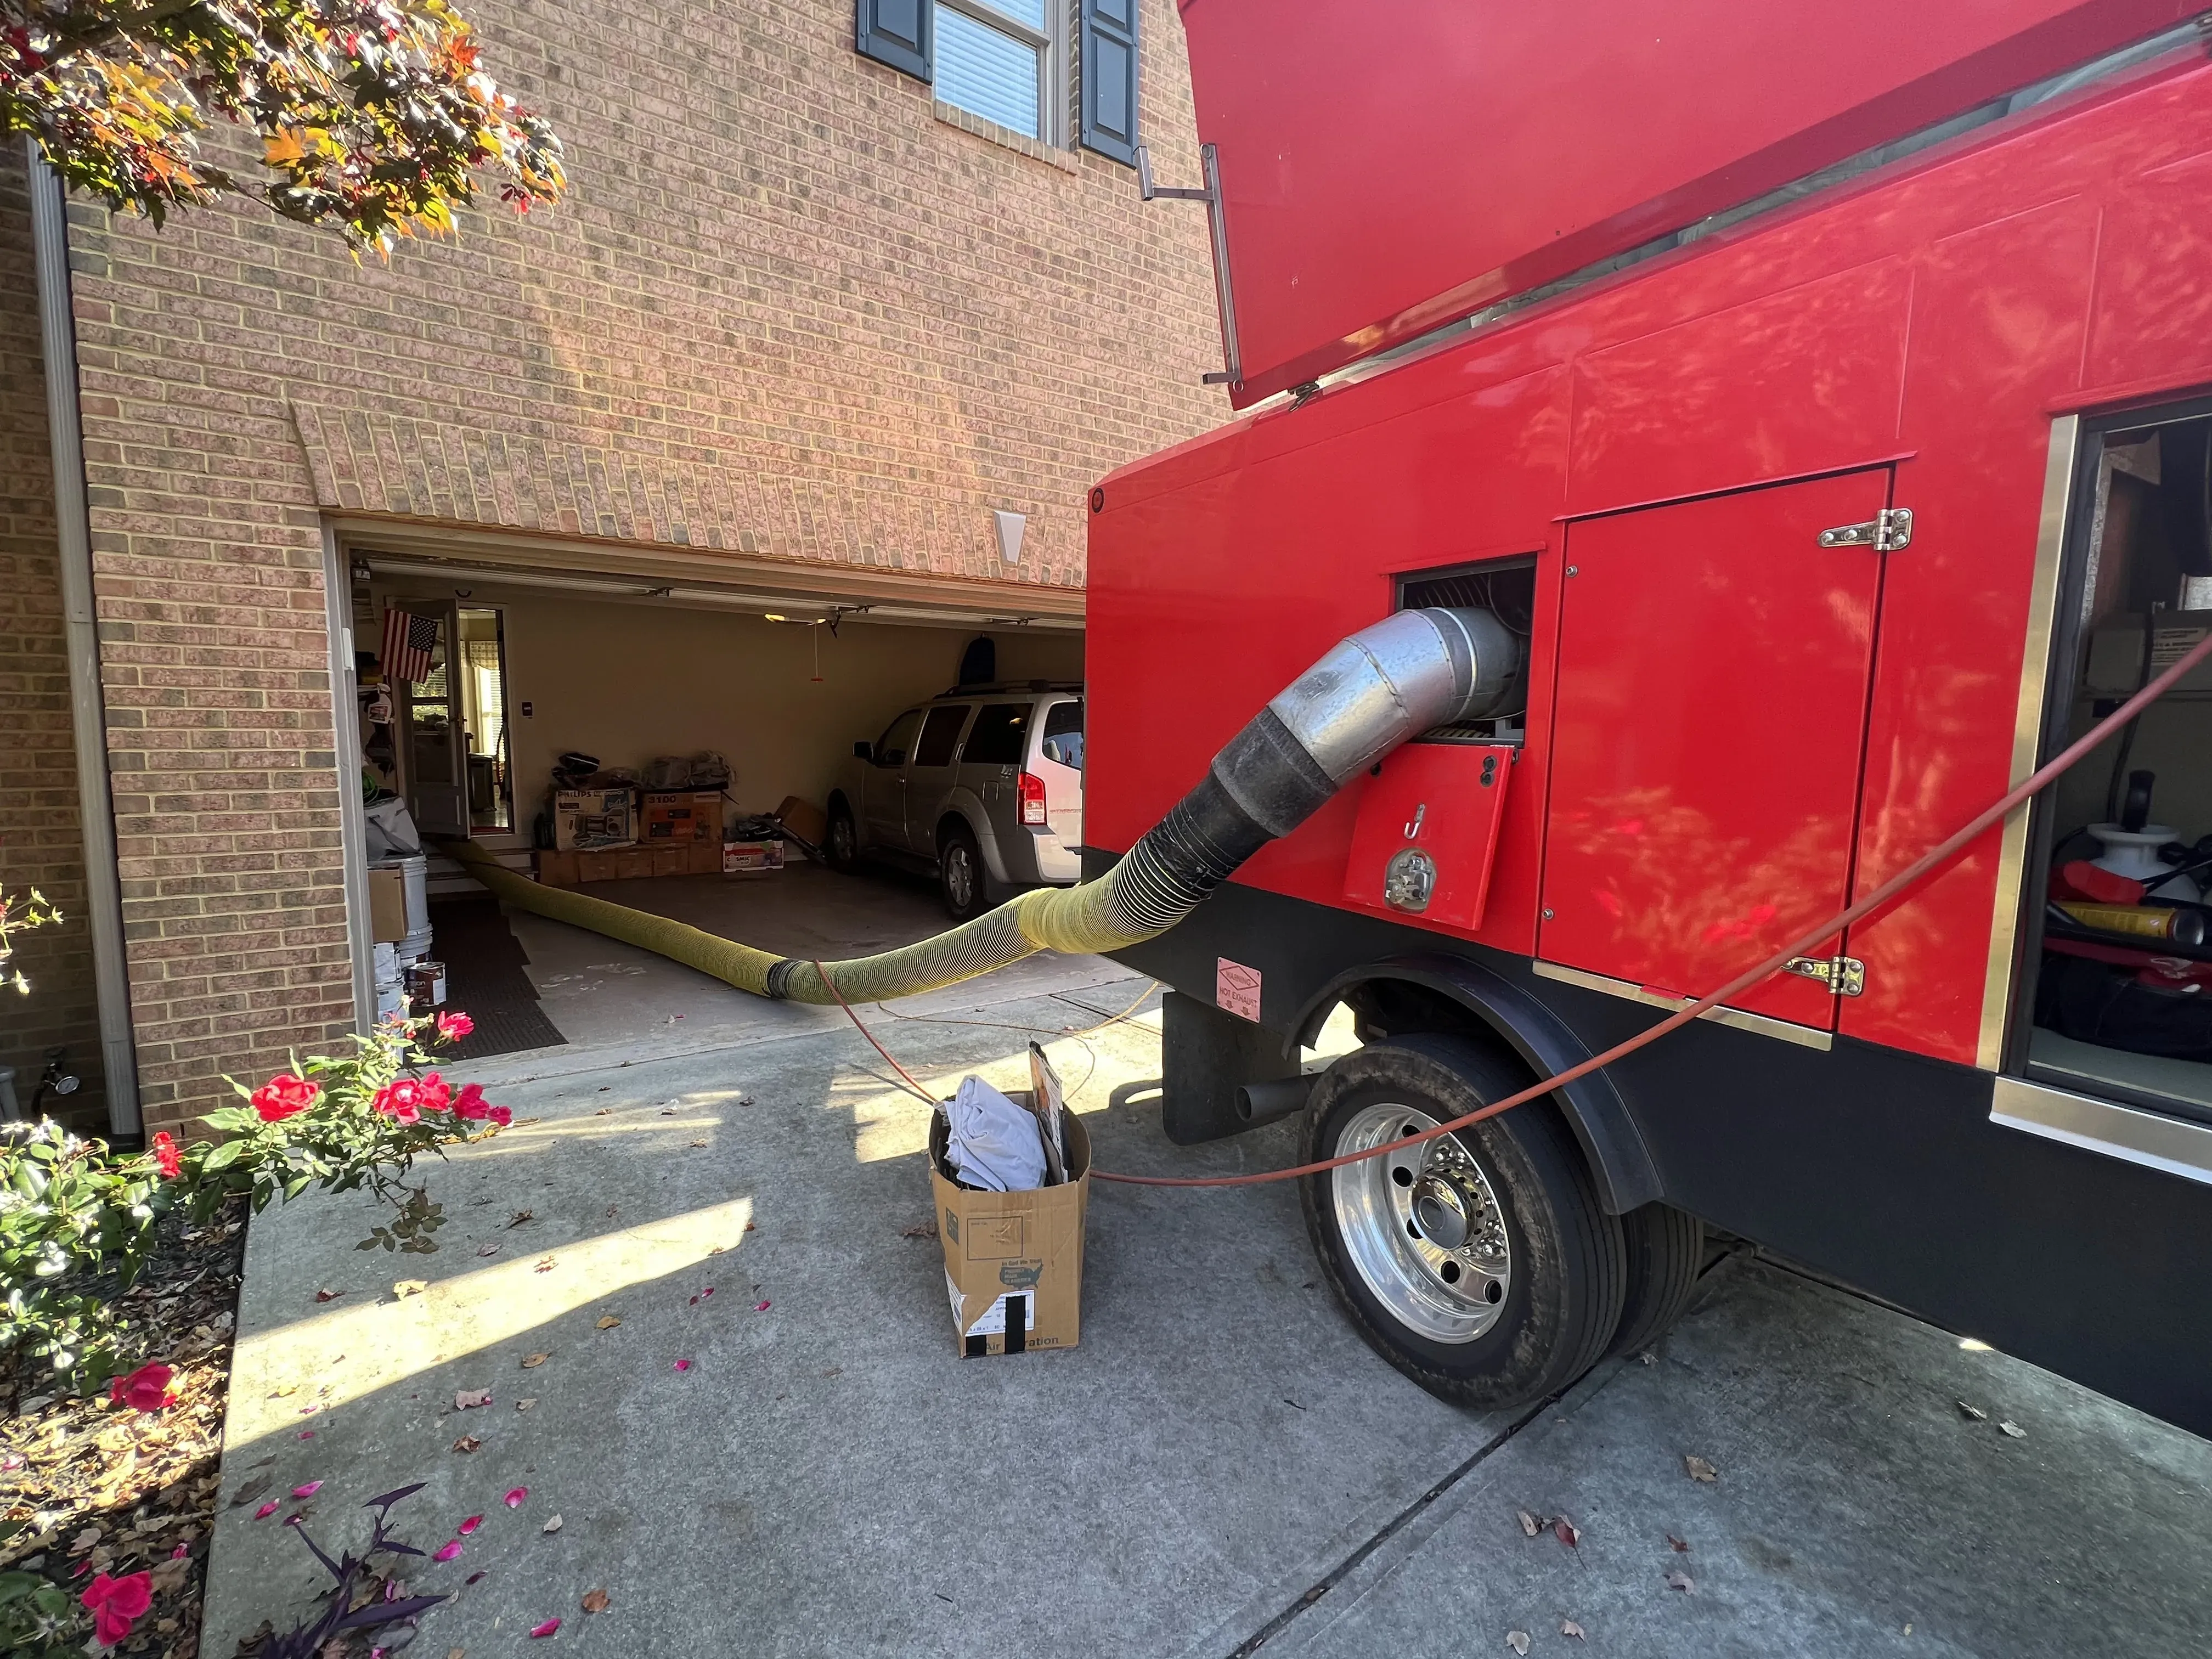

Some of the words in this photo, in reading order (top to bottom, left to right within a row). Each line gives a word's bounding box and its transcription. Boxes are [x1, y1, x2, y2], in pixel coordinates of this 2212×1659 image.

[648, 795, 676, 804] 3100
[1226, 970, 1251, 986] WARNING
[1219, 986, 1231, 997] HOT
[1232, 991, 1257, 1008] EXHAUST
